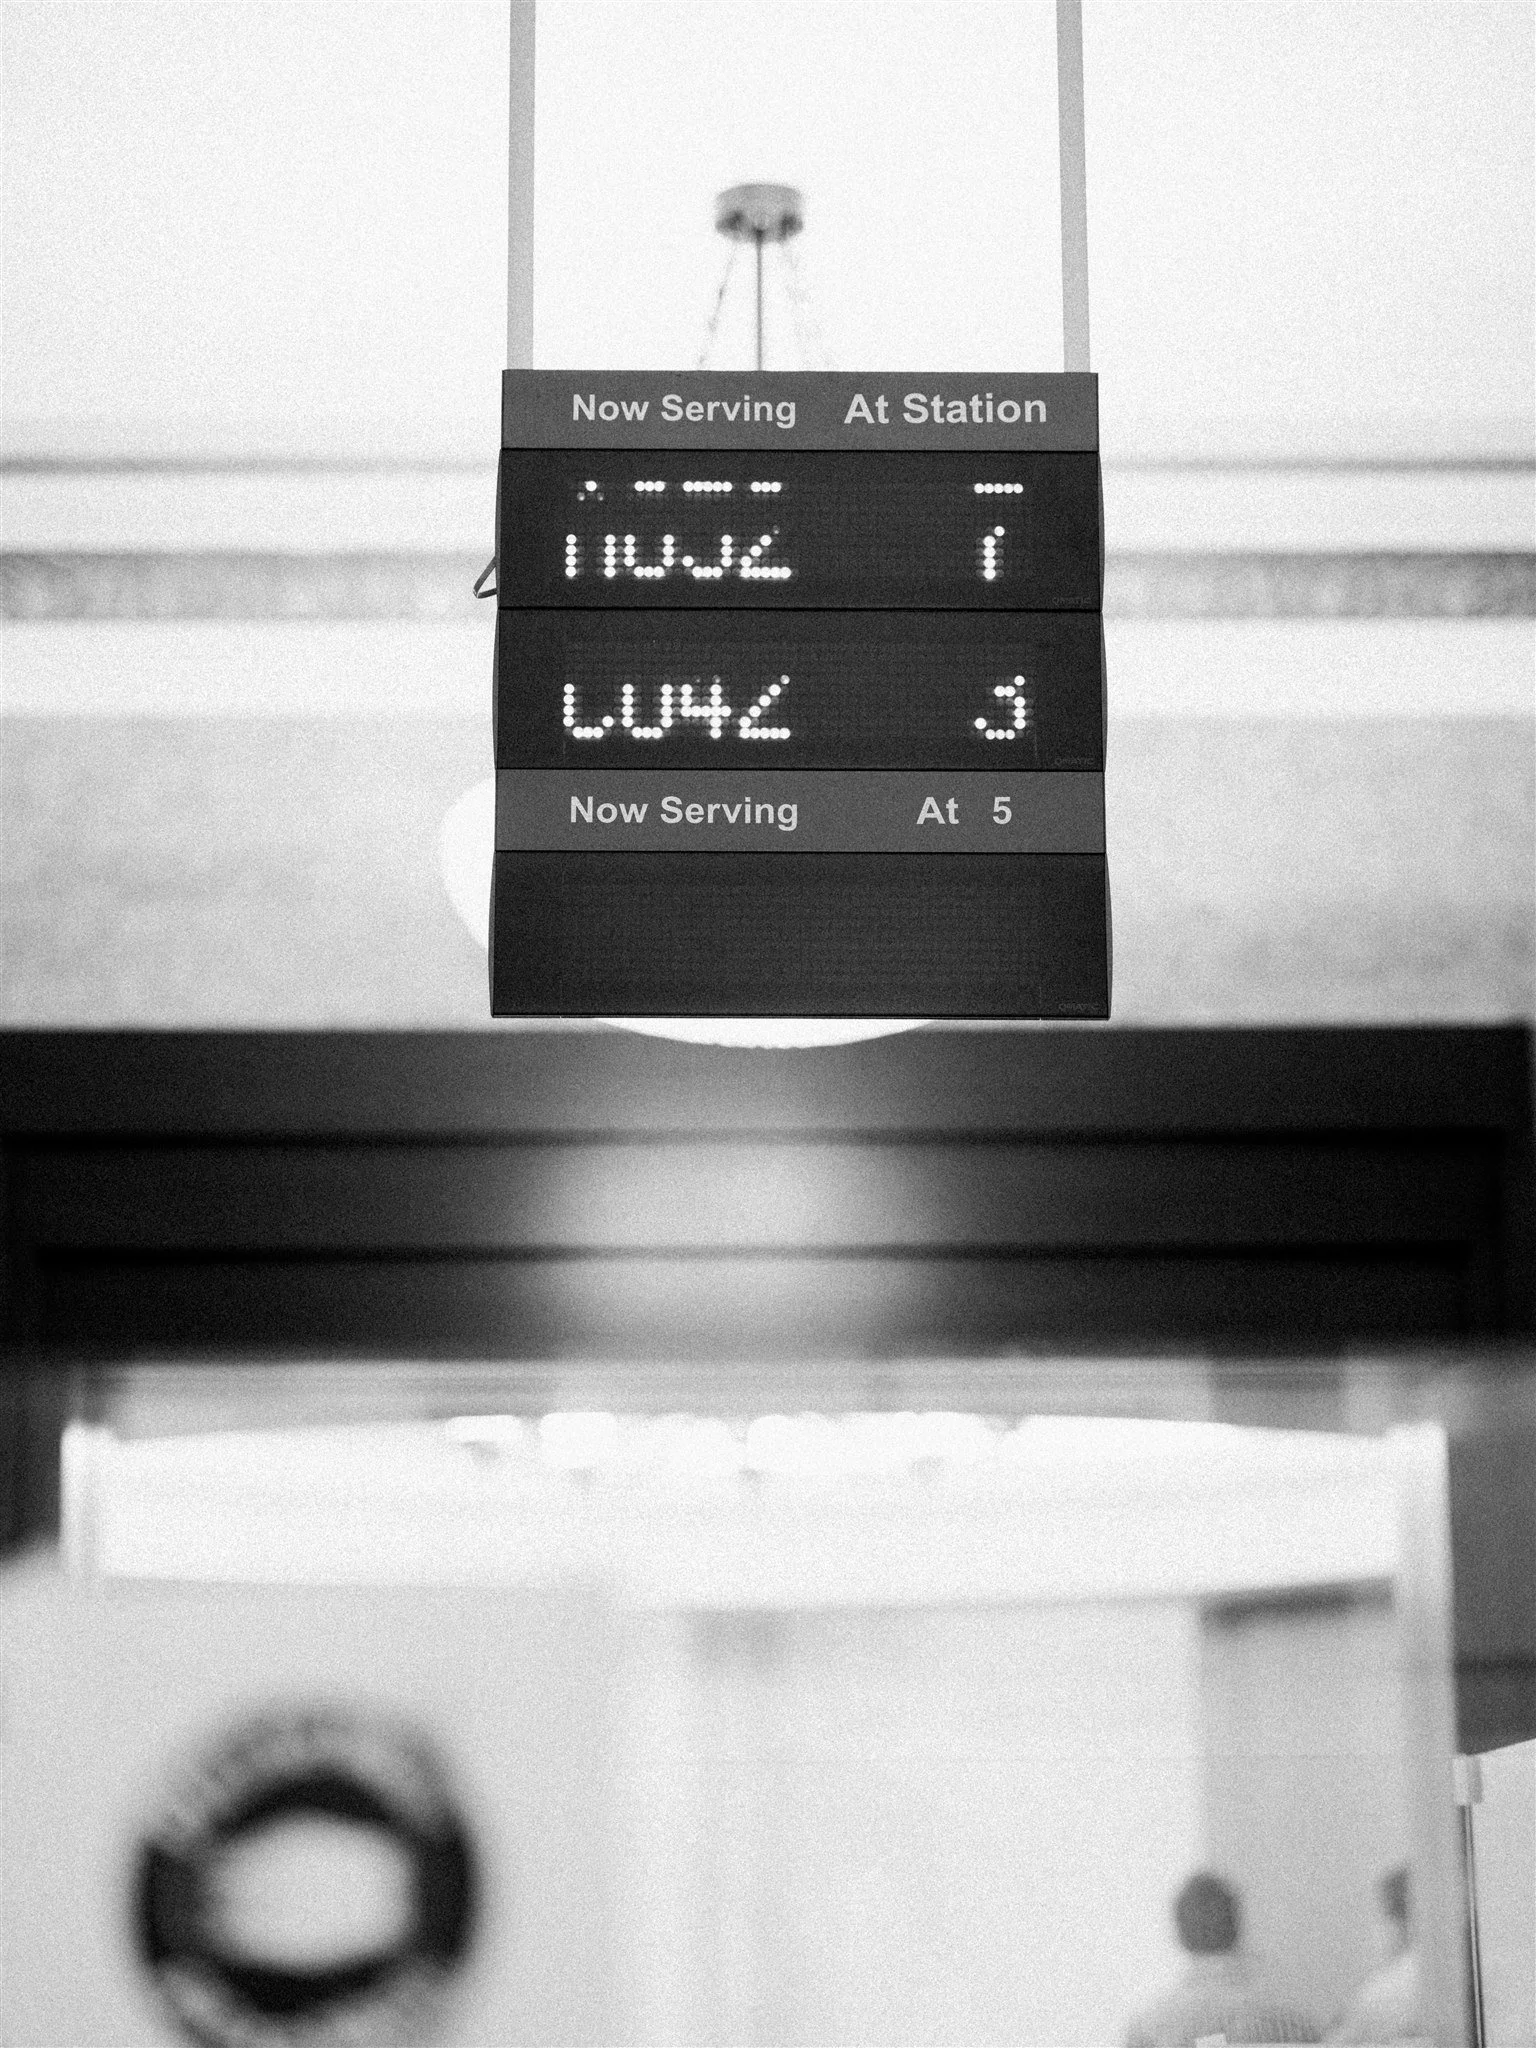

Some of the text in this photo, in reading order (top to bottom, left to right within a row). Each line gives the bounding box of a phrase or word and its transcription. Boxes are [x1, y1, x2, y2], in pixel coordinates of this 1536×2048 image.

[573, 394, 798, 429] Now Serving
[844, 393, 1049, 425] At Station
[570, 796, 799, 832] Now Serving
[916, 797, 1013, 826] At 5
